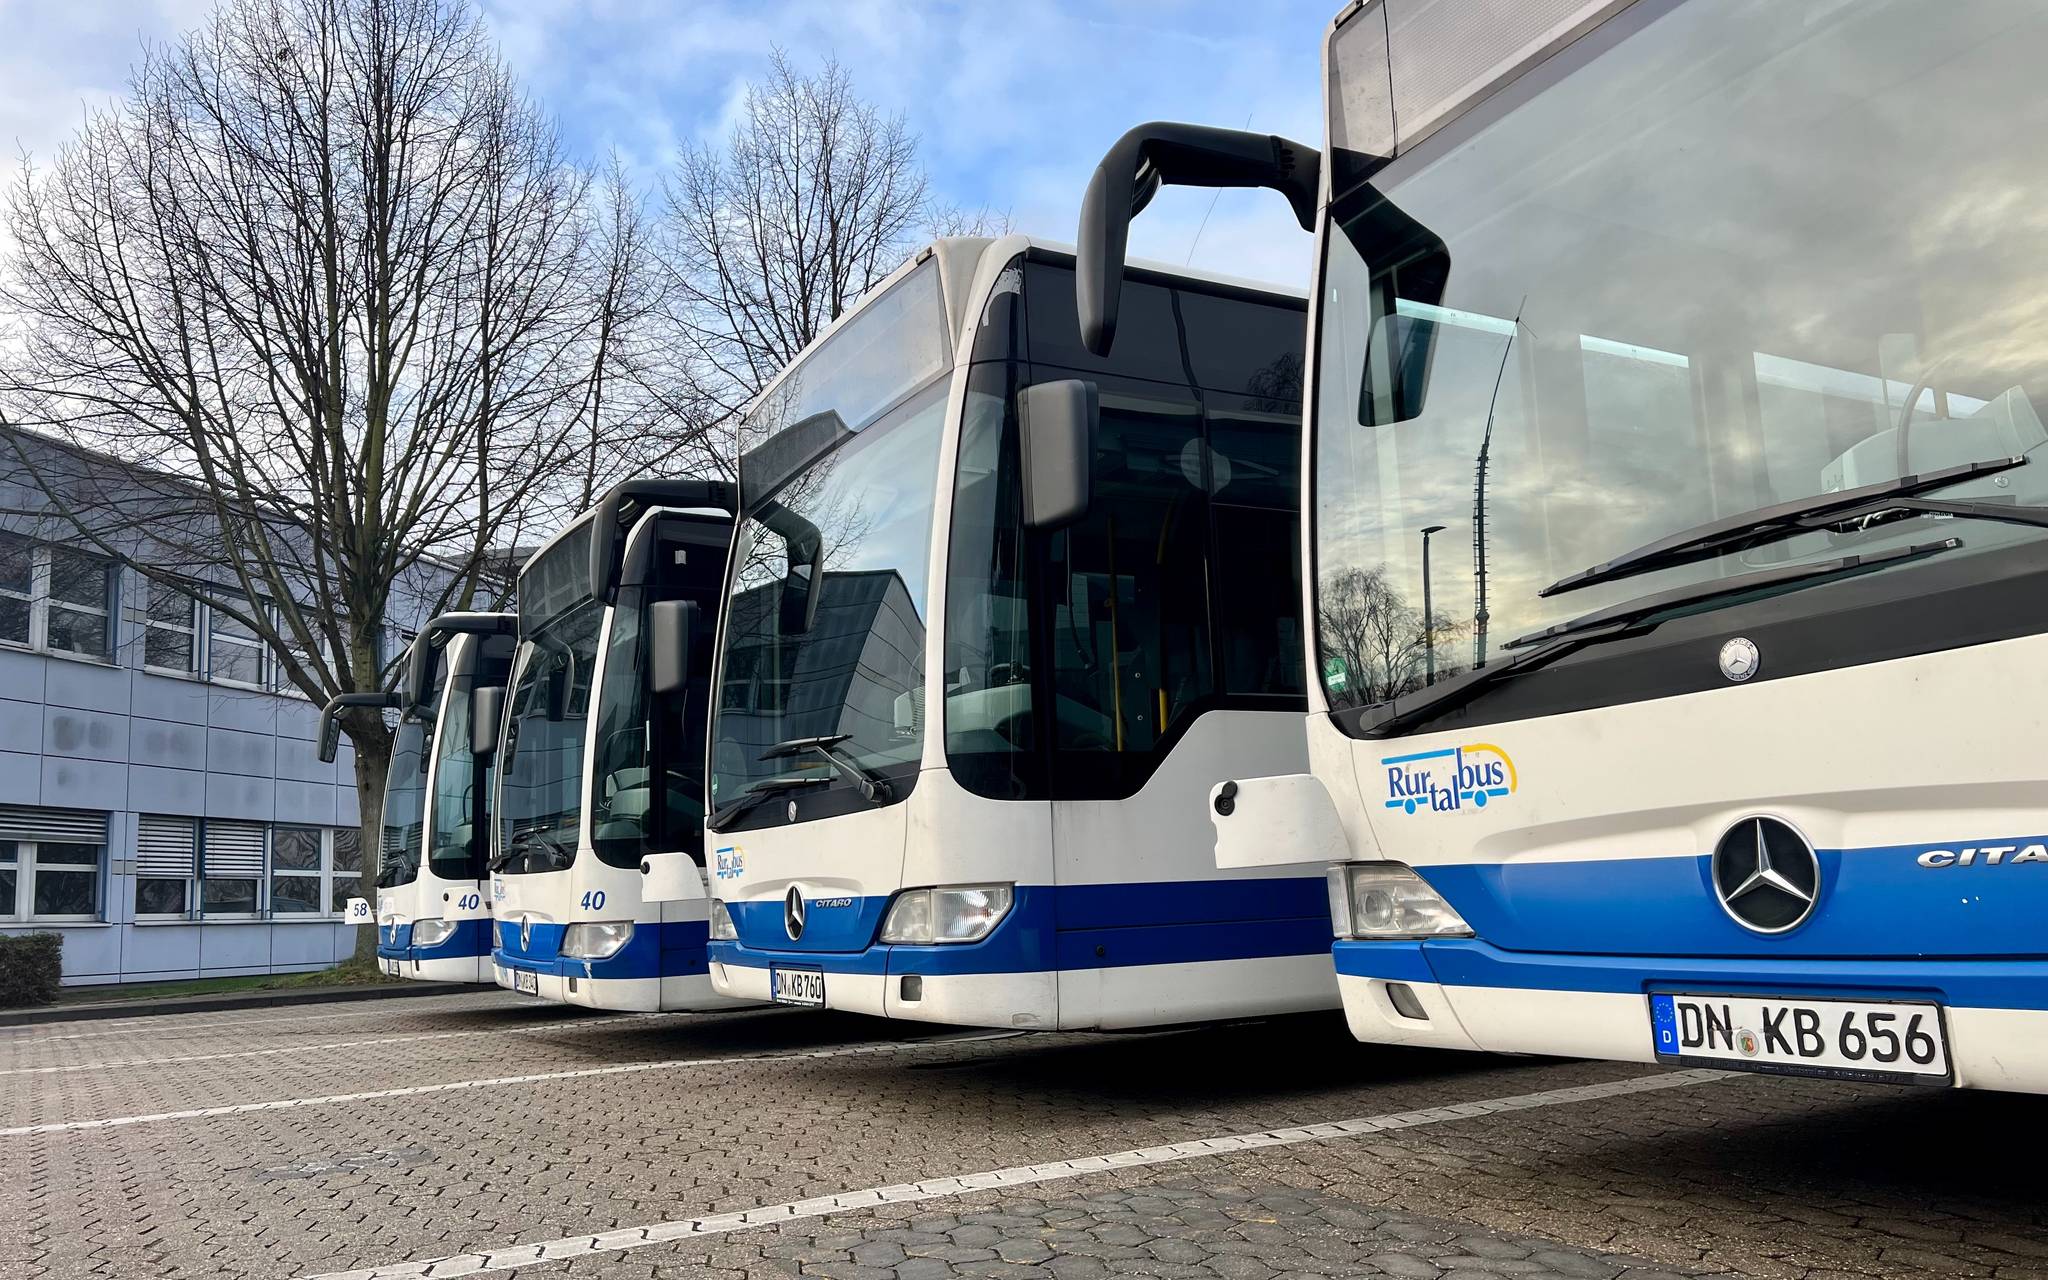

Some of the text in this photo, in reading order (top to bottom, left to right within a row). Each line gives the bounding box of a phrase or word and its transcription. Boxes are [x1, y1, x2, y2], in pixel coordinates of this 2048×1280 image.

[458, 894, 479, 910] 40
[581, 890, 606, 911] 40
[815, 898, 852, 908] CITARO
[353, 902, 367, 917] 58
[776, 972, 822, 999] DN KB 760
[1662, 1030, 1672, 1044] D
[1677, 1002, 1936, 1064] DN KB 656
